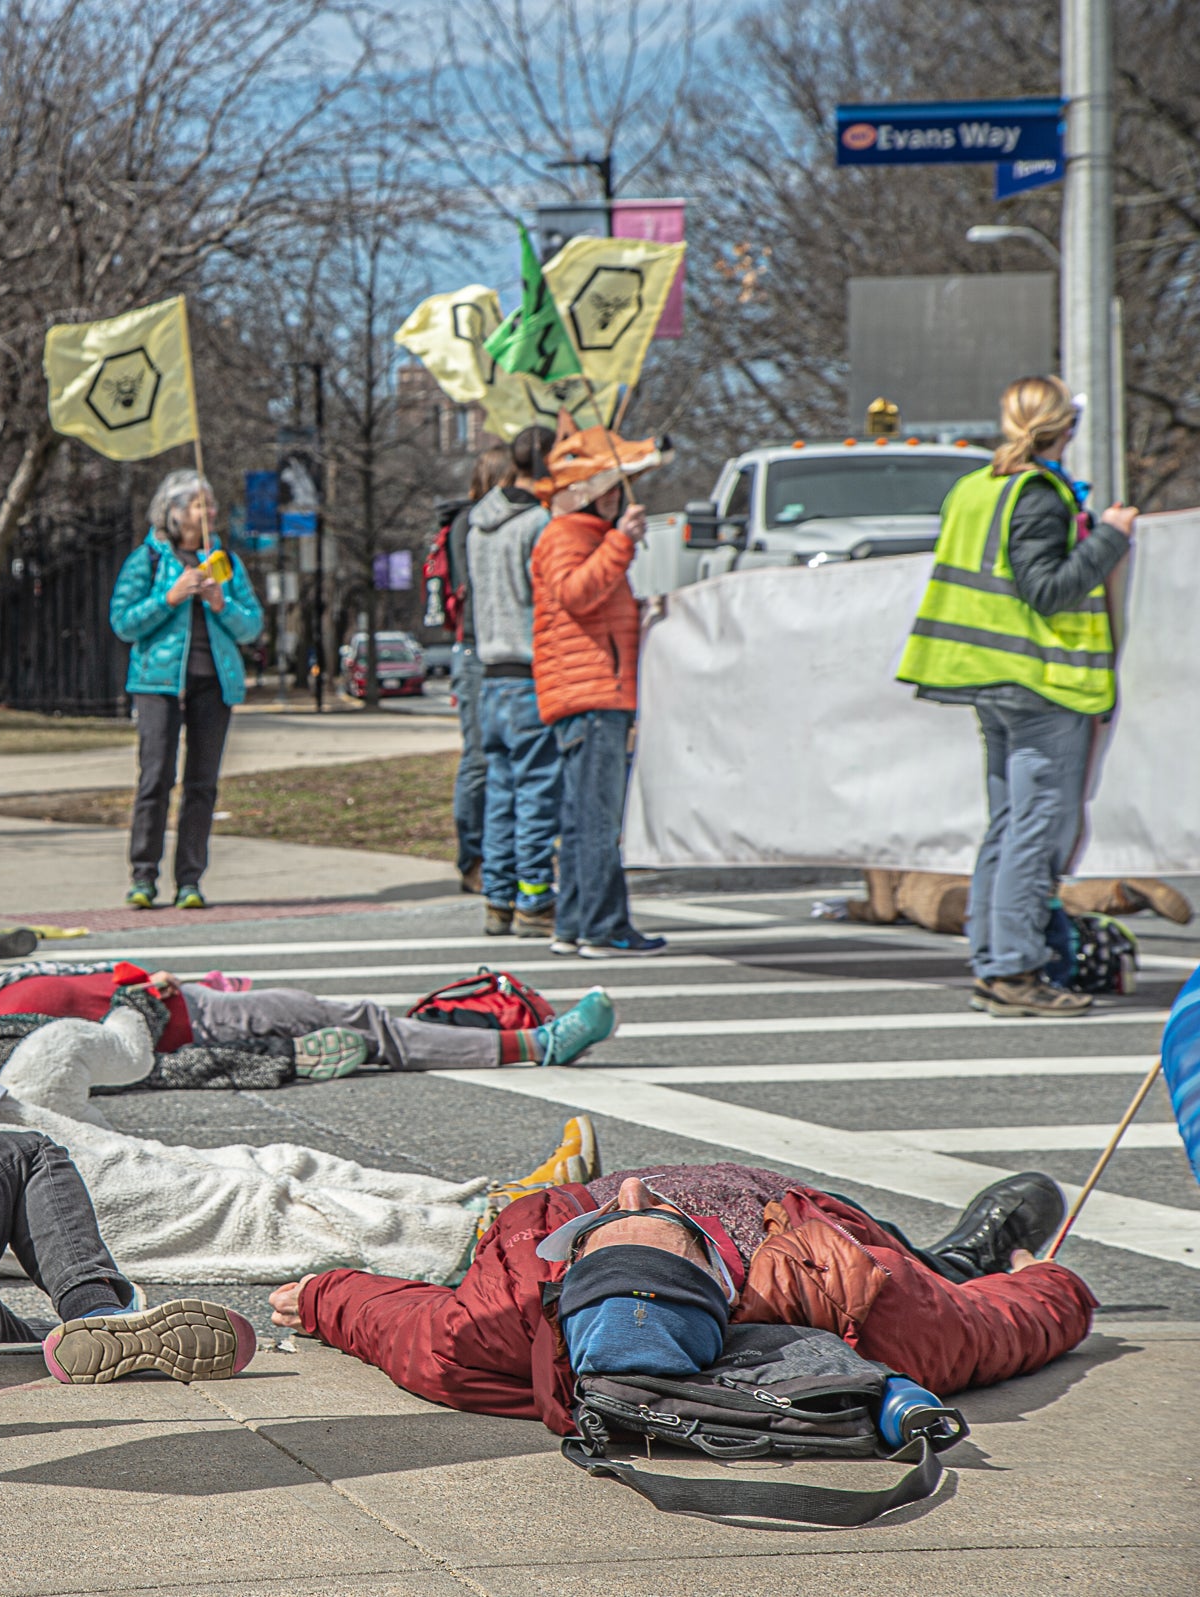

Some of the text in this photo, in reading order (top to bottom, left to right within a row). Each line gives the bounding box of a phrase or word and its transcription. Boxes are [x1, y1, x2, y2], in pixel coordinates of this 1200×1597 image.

[877, 122, 1021, 153] Evans Way
[505, 1228, 534, 1248] Rab
